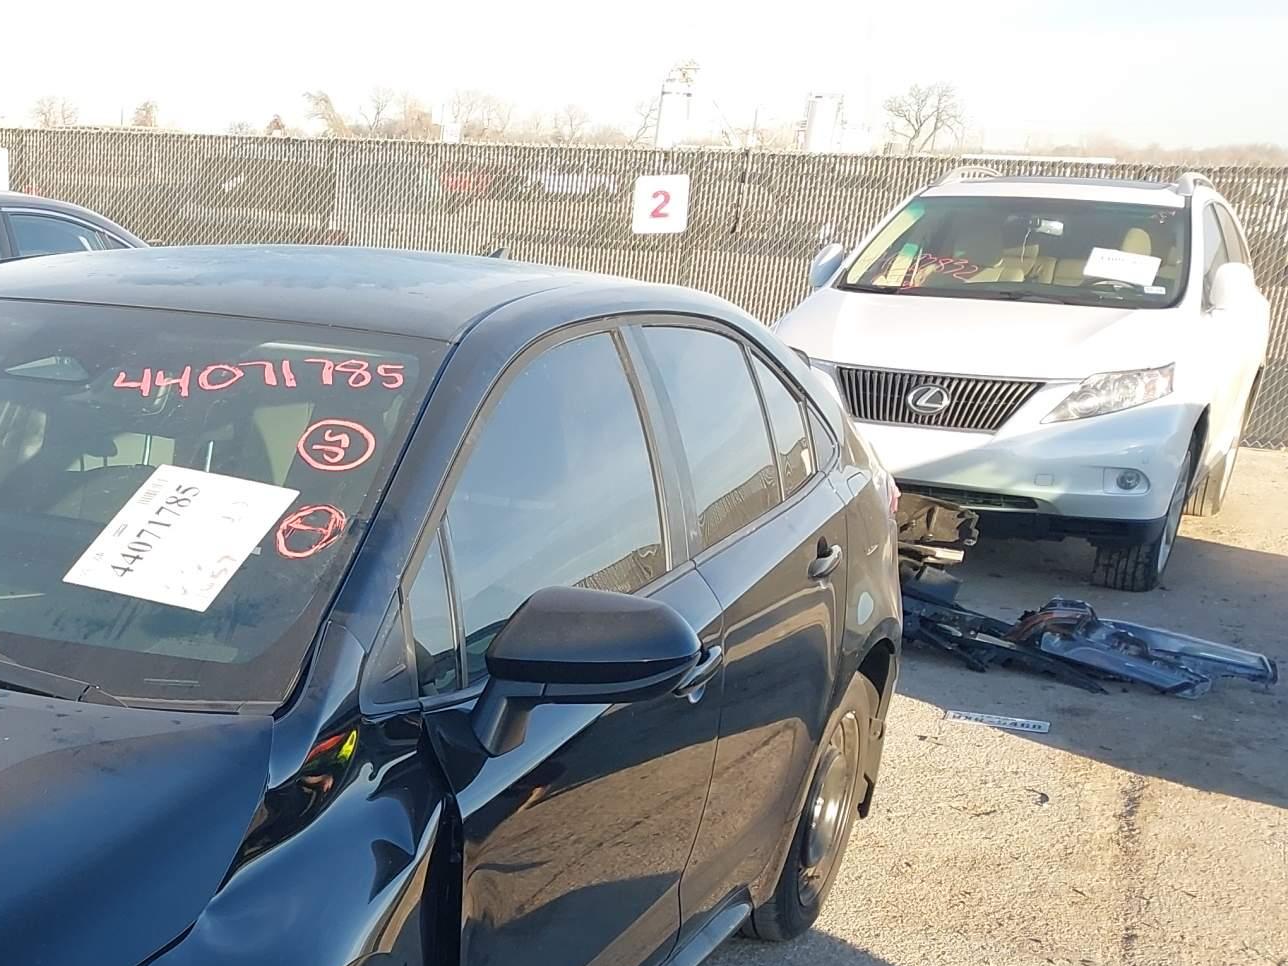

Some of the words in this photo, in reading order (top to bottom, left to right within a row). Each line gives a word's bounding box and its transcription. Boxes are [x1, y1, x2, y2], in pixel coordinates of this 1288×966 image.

[650, 190, 671, 218] 2
[112, 358, 404, 397] 44071785
[110, 484, 201, 578] 44071785
